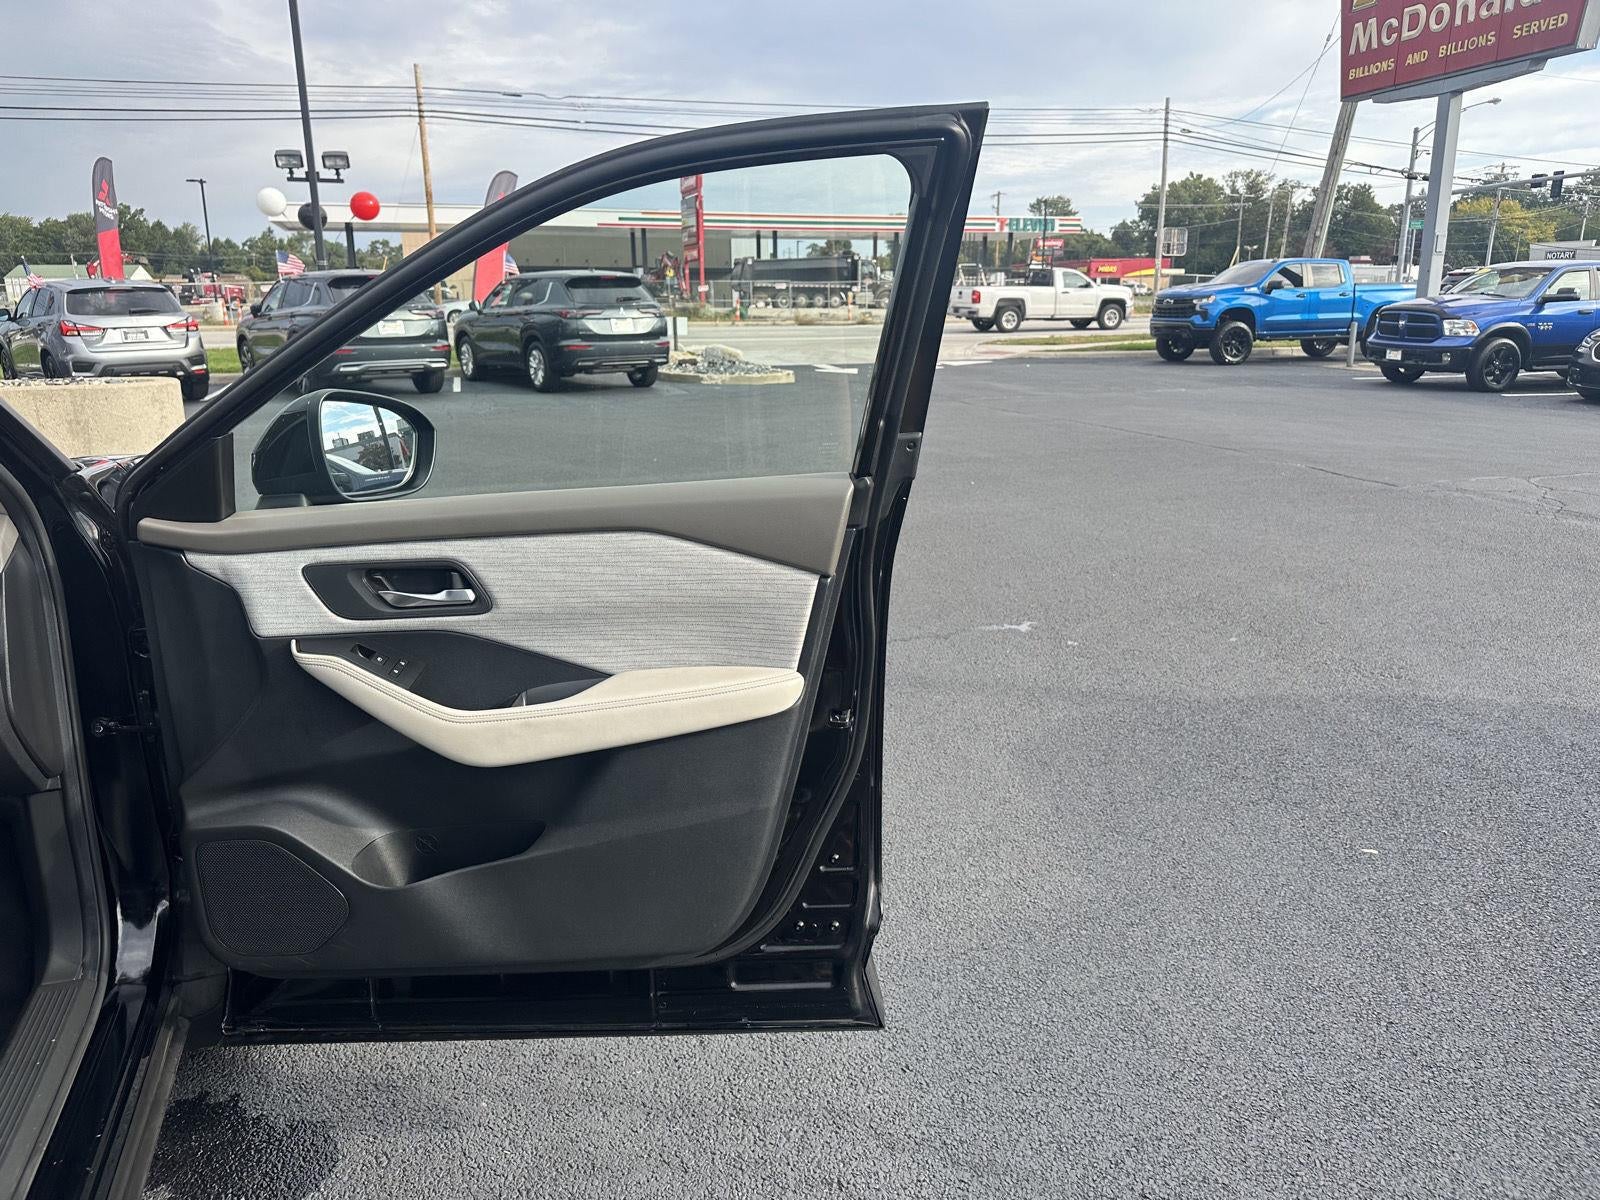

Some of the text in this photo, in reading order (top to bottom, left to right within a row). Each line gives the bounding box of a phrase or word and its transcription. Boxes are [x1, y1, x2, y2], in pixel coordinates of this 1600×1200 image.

[1348, 0, 1541, 56] McDona
[1348, 12, 1569, 80] BILLIONS AND BILLIONS SERVED
[1546, 251, 1574, 260] NOTARY
